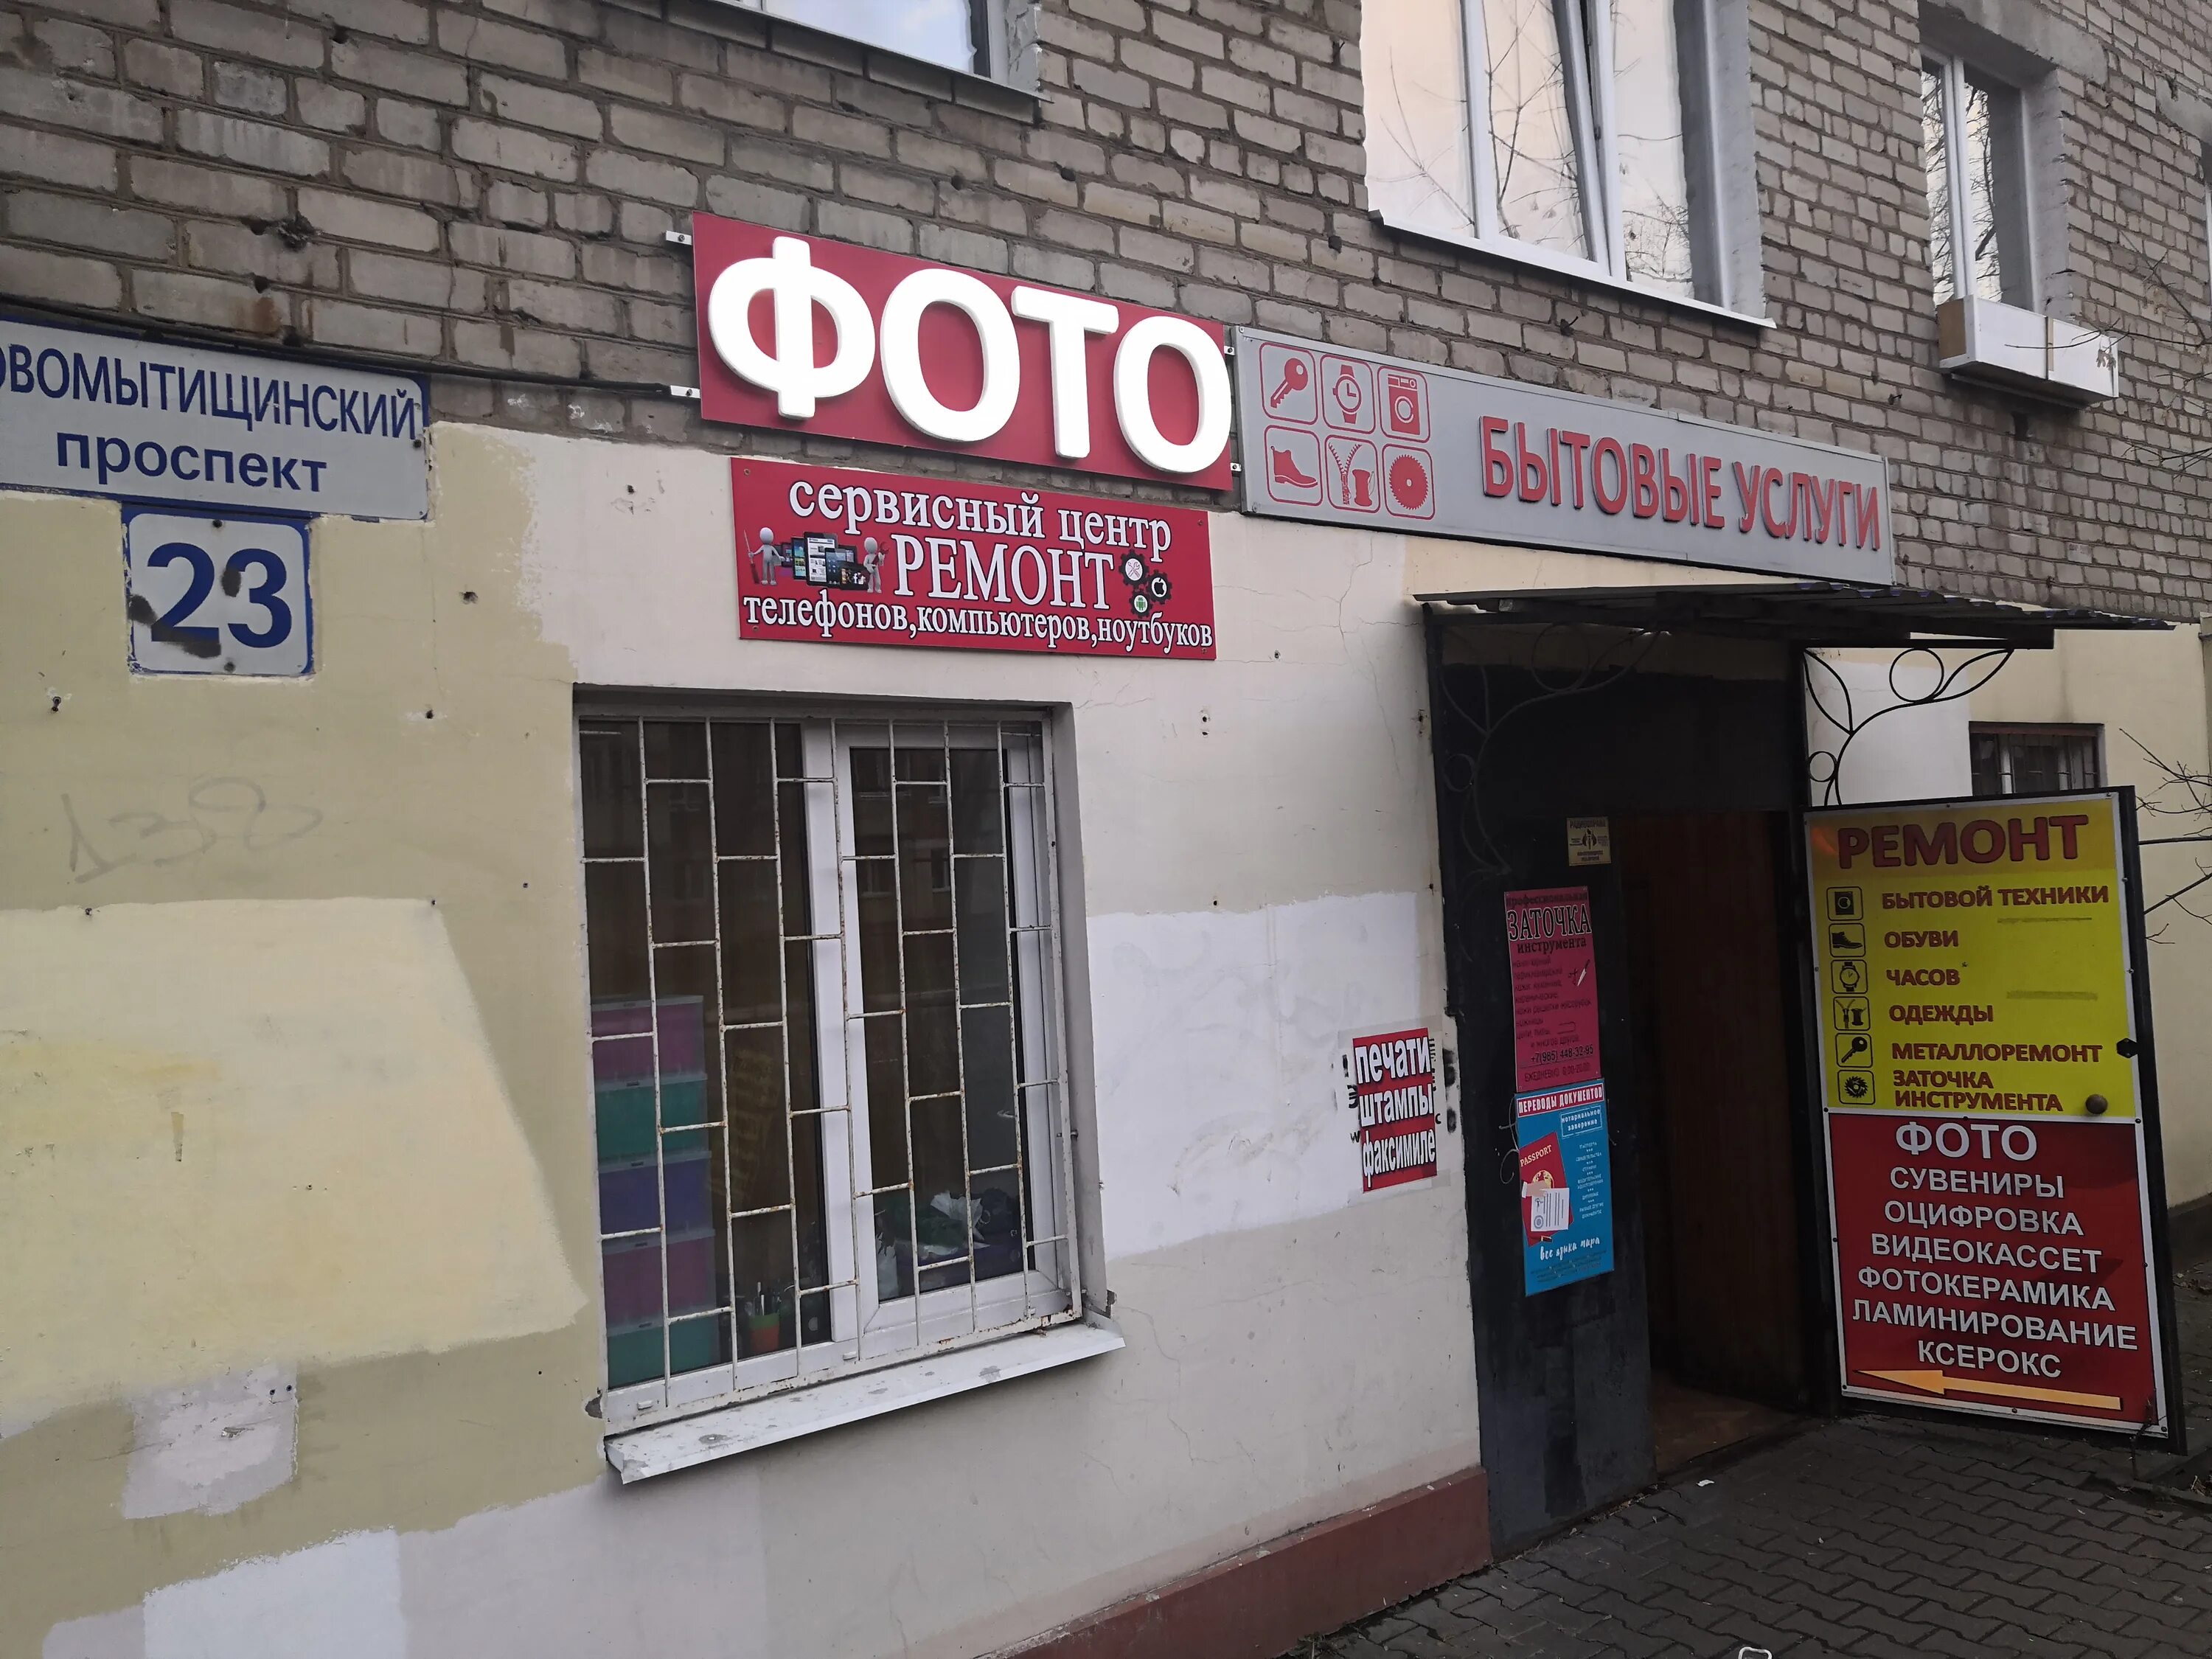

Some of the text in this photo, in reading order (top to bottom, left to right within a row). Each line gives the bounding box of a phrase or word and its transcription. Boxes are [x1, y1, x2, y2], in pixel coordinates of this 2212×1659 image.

[708, 236, 1232, 474] ФОТО
[0, 342, 416, 440] ВОМЫТИЩИНСКИЙ
[57, 431, 327, 493] проспект
[1479, 415, 1882, 551] БЫТОВЫЕ УСЛУГИ
[789, 481, 1172, 563] сервисный центр
[891, 532, 1113, 610] РЕМОНТ
[147, 542, 292, 649] 23
[1837, 813, 2089, 870] РЕМОНТ
[1882, 884, 2110, 909] БЫТОВОЙ ТЕХНИКИ
[1507, 903, 1593, 942] ЗАТОЧКА
[1884, 931, 1959, 948] ОБУВИ
[1517, 937, 1587, 955] инструмента
[1885, 968, 1961, 987] ЧАСОВ
[1888, 1004, 1994, 1026] ОДЕЖДЫ
[1354, 1035, 1431, 1085] печати
[1891, 1043, 2103, 1063] МЕТАЛЛОРЕМОНТ
[1518, 1085, 1603, 1114] ПЕРЕВОДЫ ДОКУМЕНТОВ
[1893, 1070, 1994, 1090] ЗАТОЧКА
[1358, 1082, 1434, 1127] штампы
[1894, 1090, 2064, 1113] ИНСТРУМЕНТА
[1363, 1128, 1436, 1189] факсимиле
[1519, 1144, 1553, 1168] PASSPORT
[1895, 1121, 2038, 1161] ФОТО
[1889, 1166, 2065, 1199] СУВЕНИРЫ
[1884, 1199, 2084, 1237] ОЦИФРОВКА
[1871, 1231, 2102, 1273] ВИДЕОКАССЕТ
[1857, 1266, 2116, 1312] ФОТОКЕРАМИКА
[1851, 1298, 2139, 1351] ЛАМИНИРОВАНИЕ
[1917, 1340, 2062, 1379] КСЕРОКС
